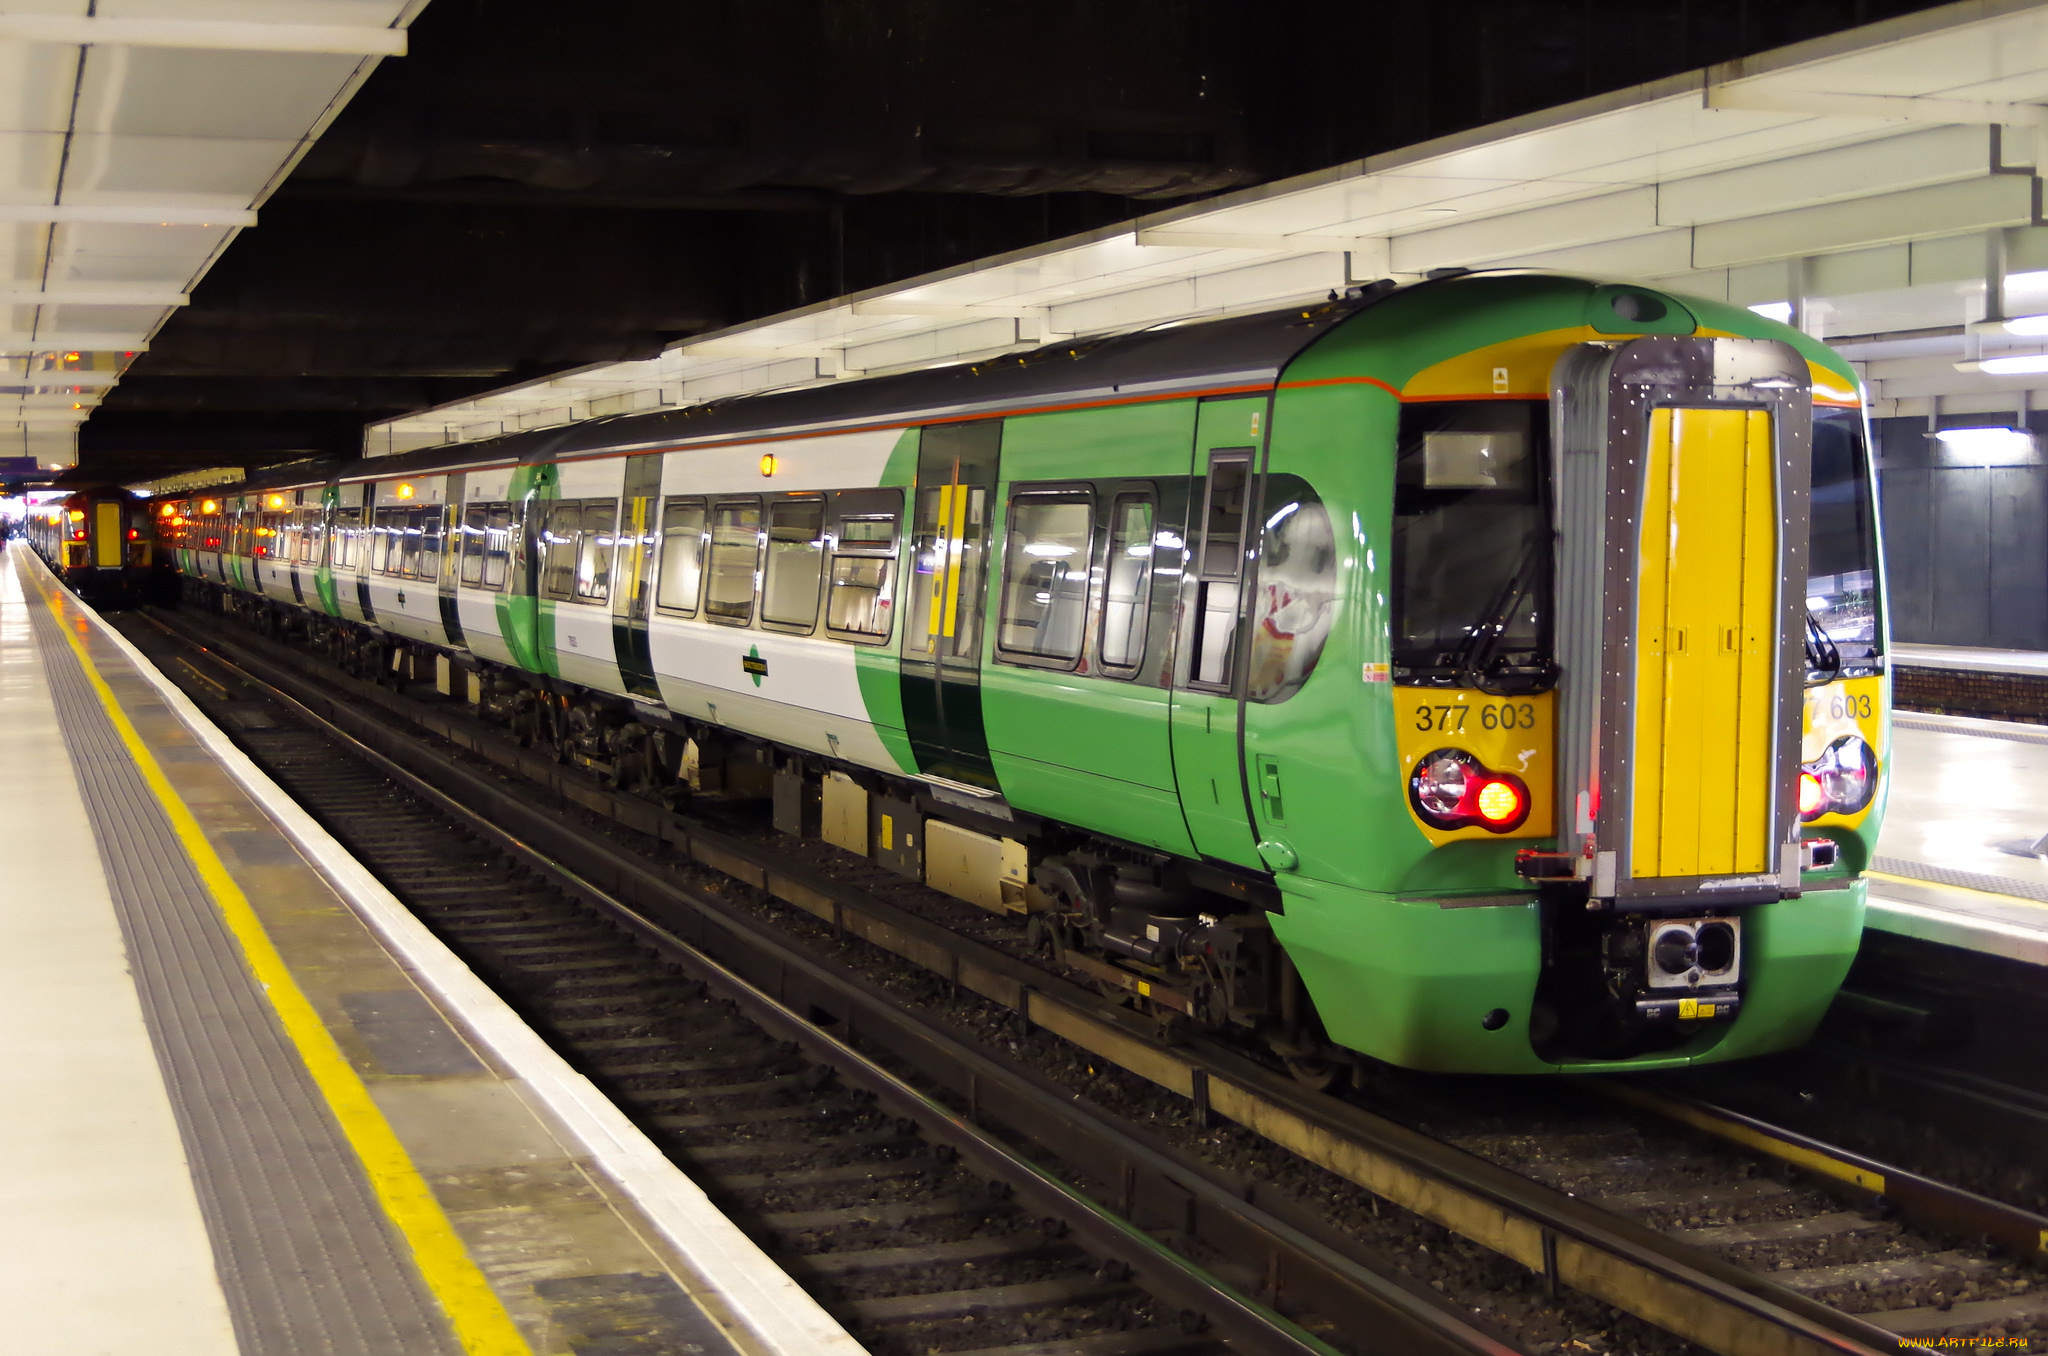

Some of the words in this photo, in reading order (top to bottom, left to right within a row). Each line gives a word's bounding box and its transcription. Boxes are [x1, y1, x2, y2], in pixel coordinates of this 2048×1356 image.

[1415, 704, 1470, 731] 377
[1481, 703, 1535, 731] 603
[1830, 694, 1872, 720] 603
